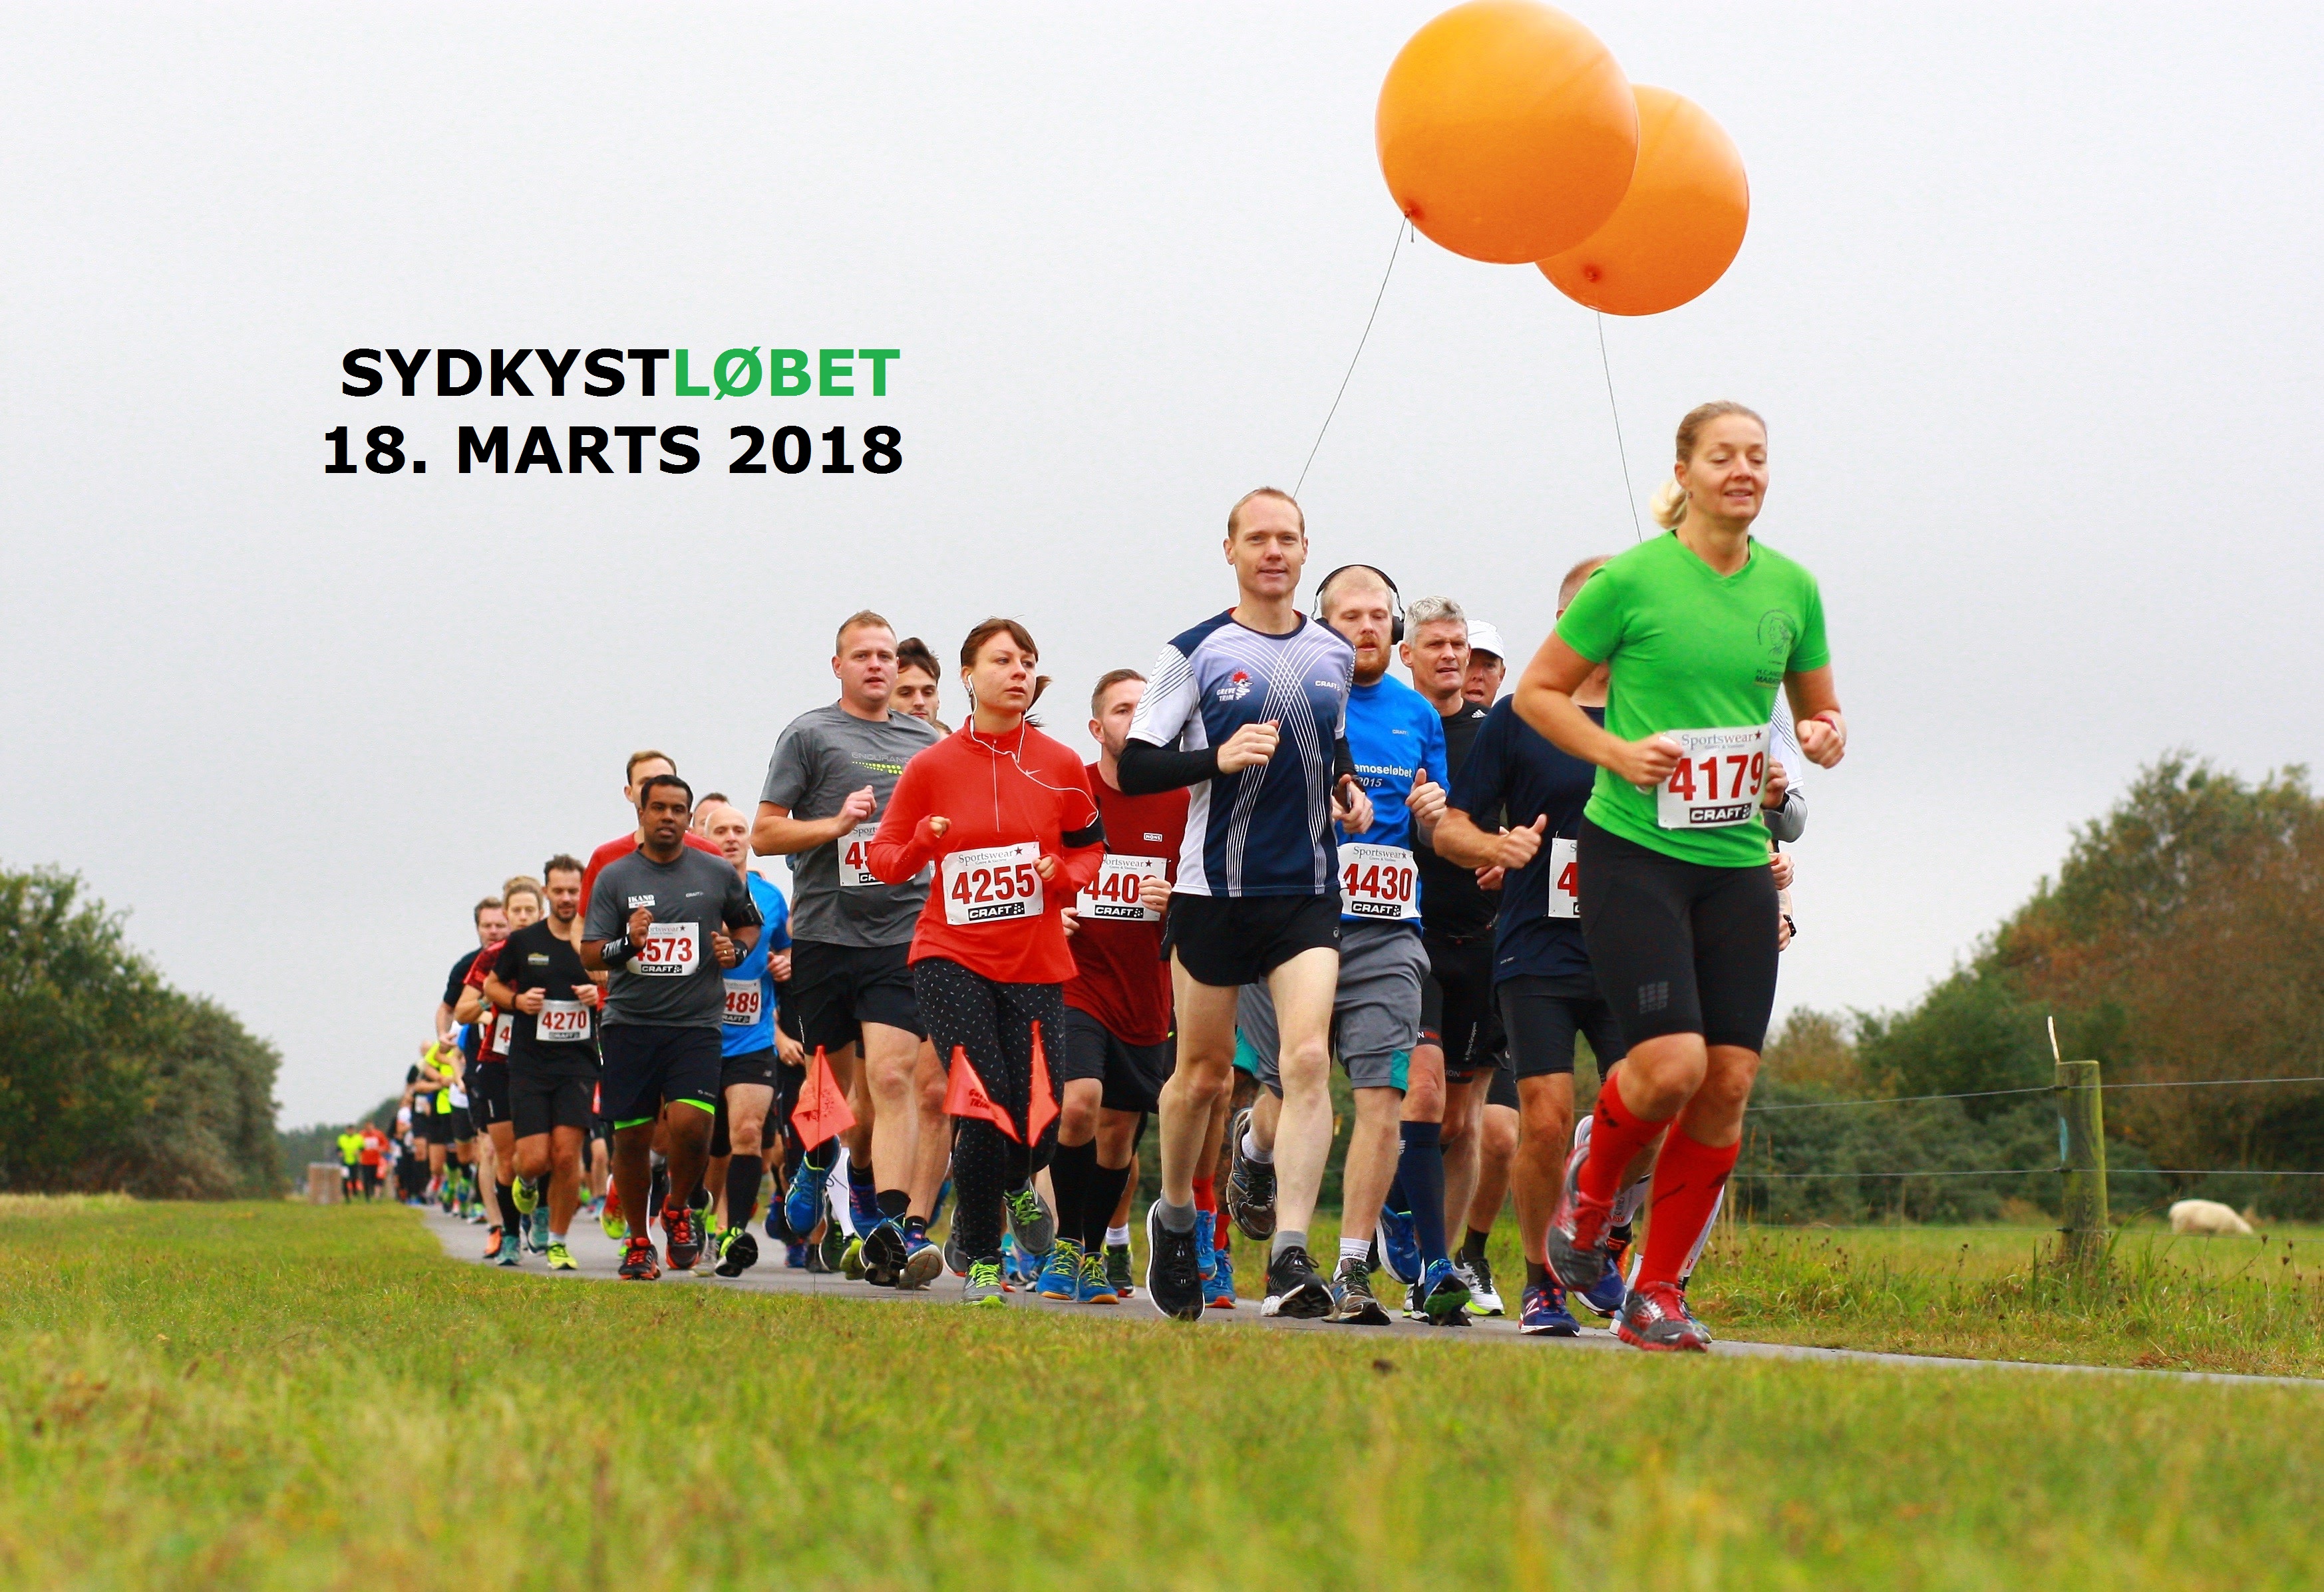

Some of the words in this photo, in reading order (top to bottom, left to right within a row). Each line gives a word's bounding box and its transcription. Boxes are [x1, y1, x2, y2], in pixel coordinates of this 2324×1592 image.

[1315, 680, 1337, 690] CRAFT
[1681, 733, 1752, 750] Sportswear
[1668, 751, 1764, 801] 4179
[1691, 805, 1743, 821] CRAFT
[958, 850, 1013, 866] Sportswear
[1353, 846, 1401, 859] Sportswear
[951, 863, 1035, 905] 4255
[1083, 873, 1157, 903] 440
[1343, 863, 1412, 902] 4430
[628, 894, 655, 903] IKANO
[969, 905, 1012, 919] CRAFT
[1095, 906, 1134, 916] CRAFT
[1353, 903, 1393, 914] CRAFT
[542, 1010, 587, 1031] 4270
